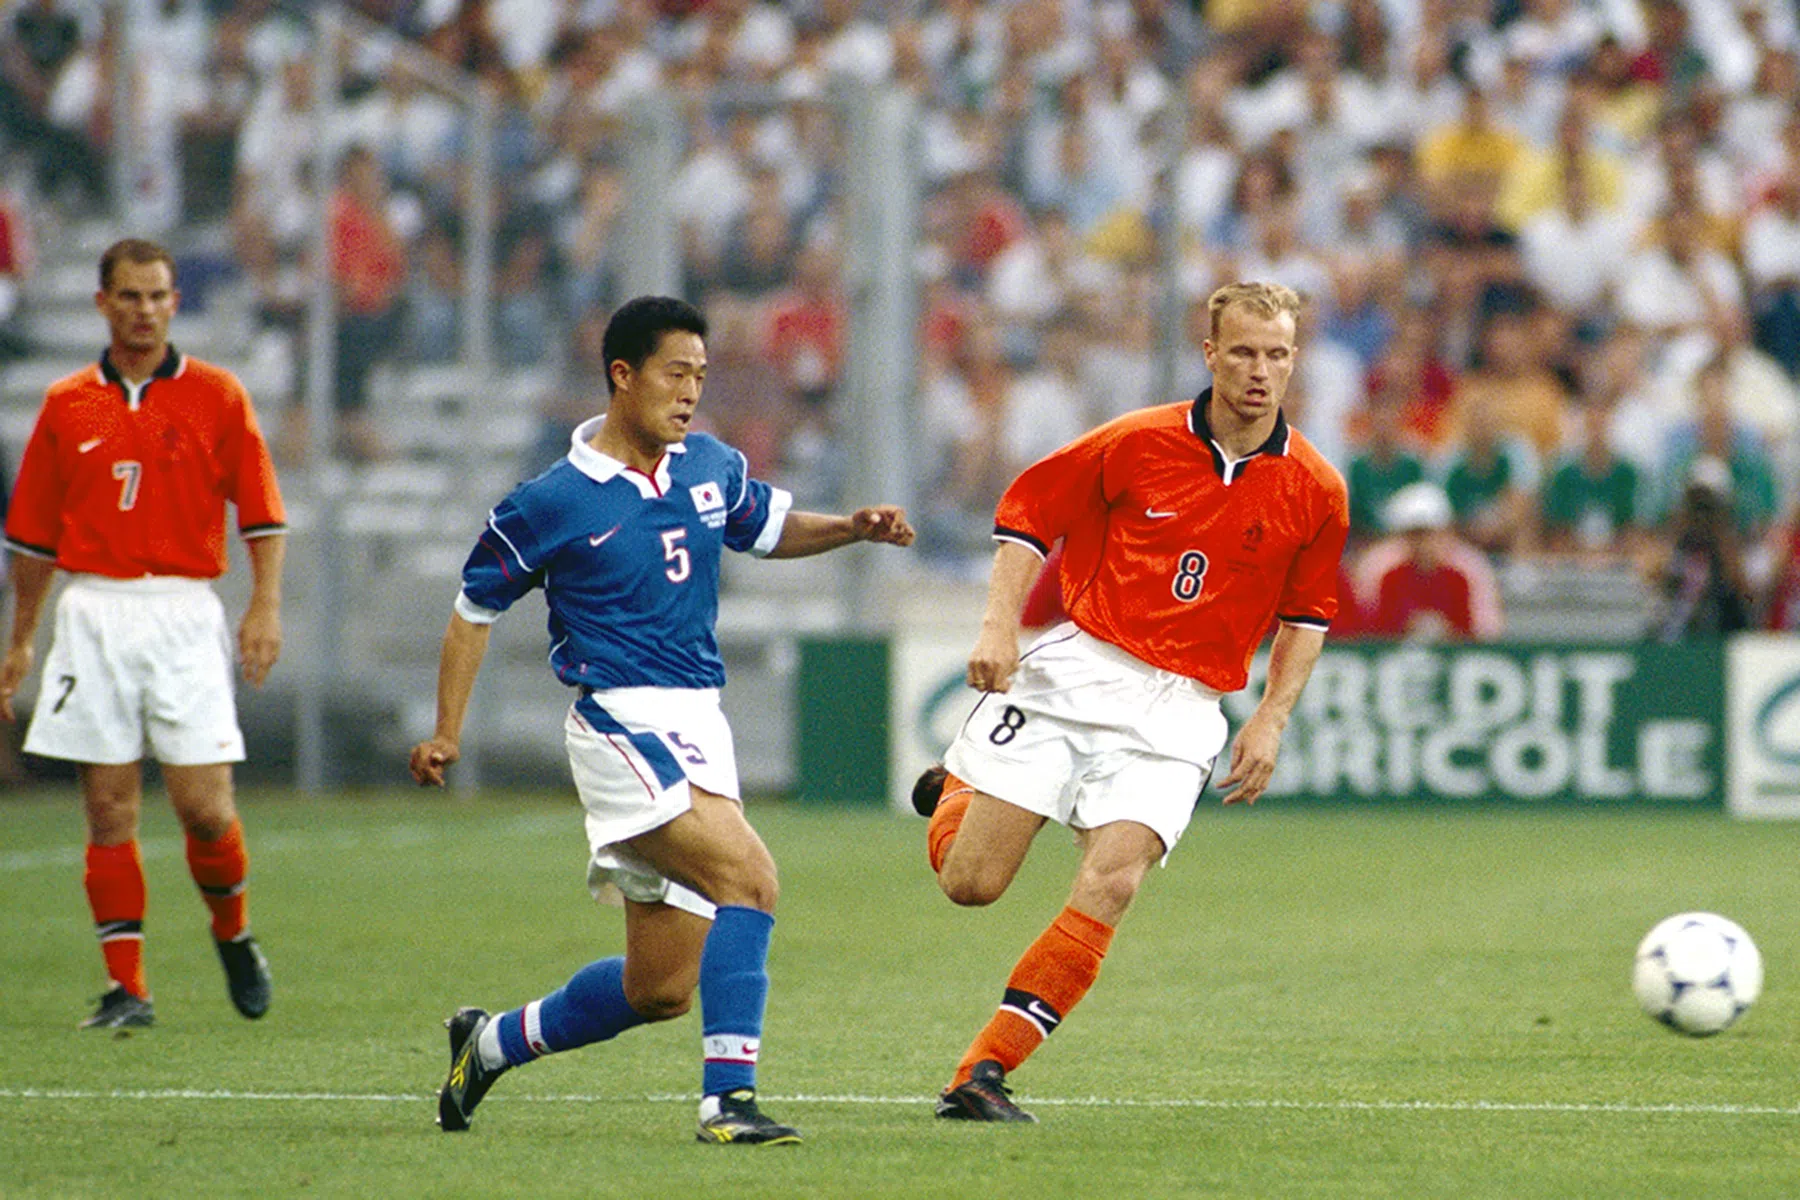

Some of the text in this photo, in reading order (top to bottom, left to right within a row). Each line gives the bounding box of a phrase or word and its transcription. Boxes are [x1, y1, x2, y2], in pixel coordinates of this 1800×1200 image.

[113, 460, 141, 511] 7
[661, 528, 691, 583] 5
[1172, 550, 1208, 602] 8
[53, 674, 77, 714] 7
[989, 704, 1026, 745] 8
[666, 731, 707, 765] 5
